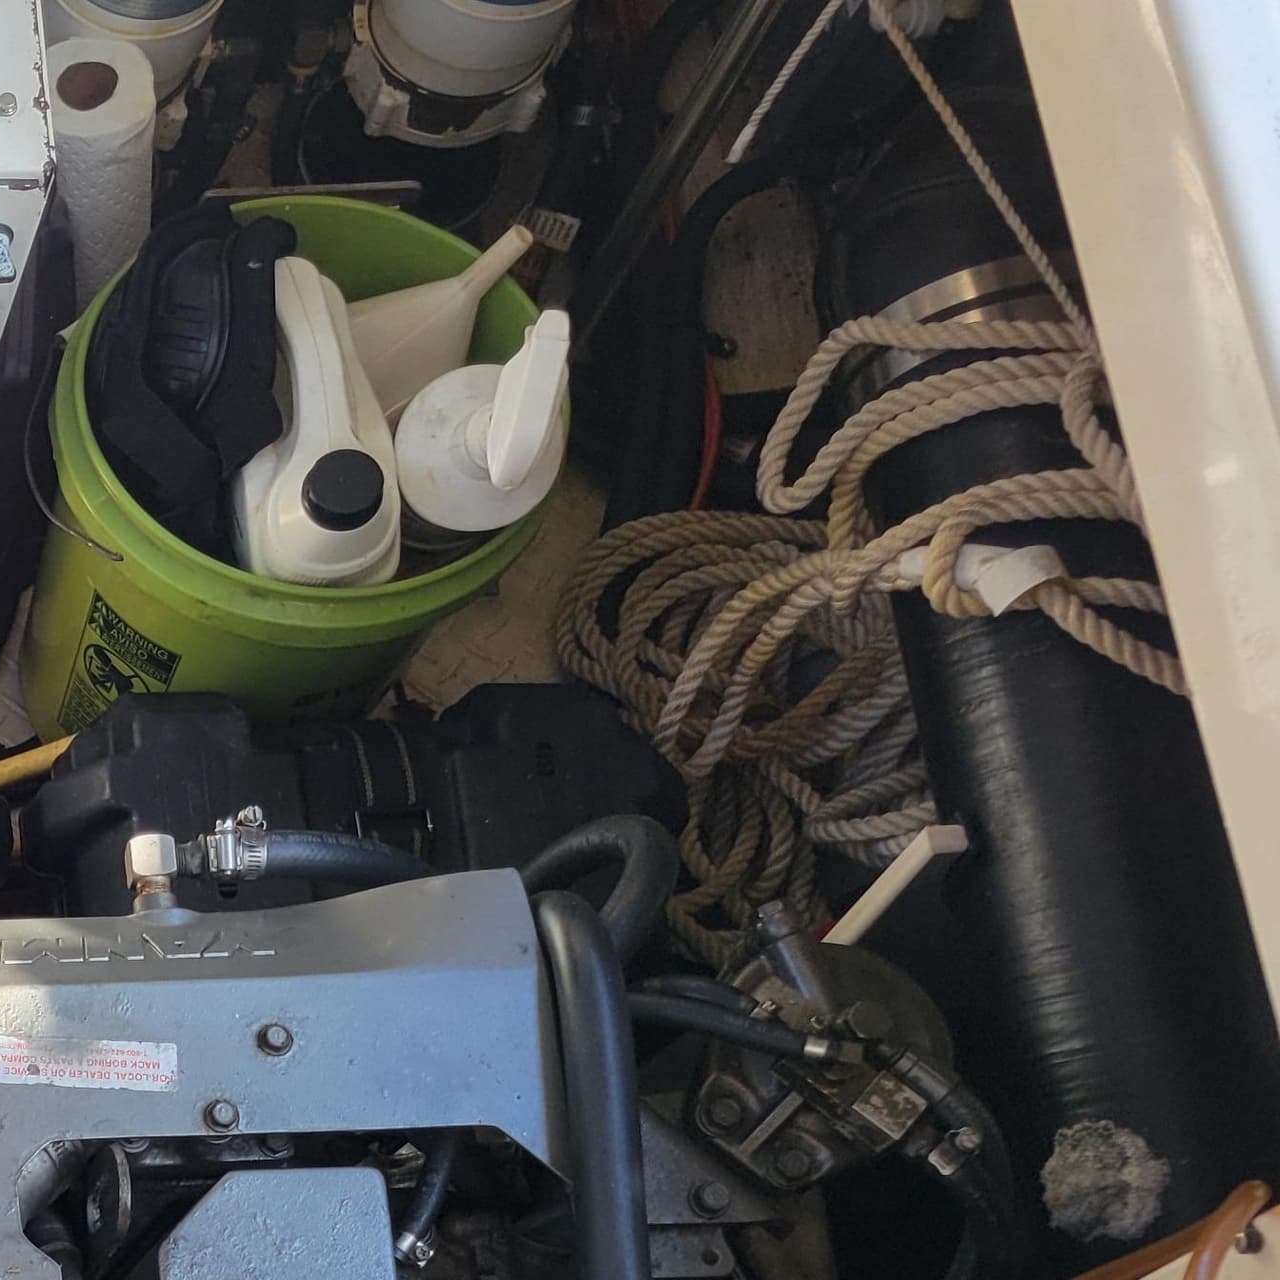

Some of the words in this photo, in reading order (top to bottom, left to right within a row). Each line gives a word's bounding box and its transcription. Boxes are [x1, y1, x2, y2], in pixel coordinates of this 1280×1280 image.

[107, 609, 170, 661] WARNING
[86, 1059, 128, 1068] BORING
[130, 1061, 160, 1070] MACK
[4, 1067, 48, 1076] SVICE
[51, 1069, 66, 1077] OR
[69, 1070, 110, 1080] DEALER
[114, 1072, 150, 1081] LOCAL
